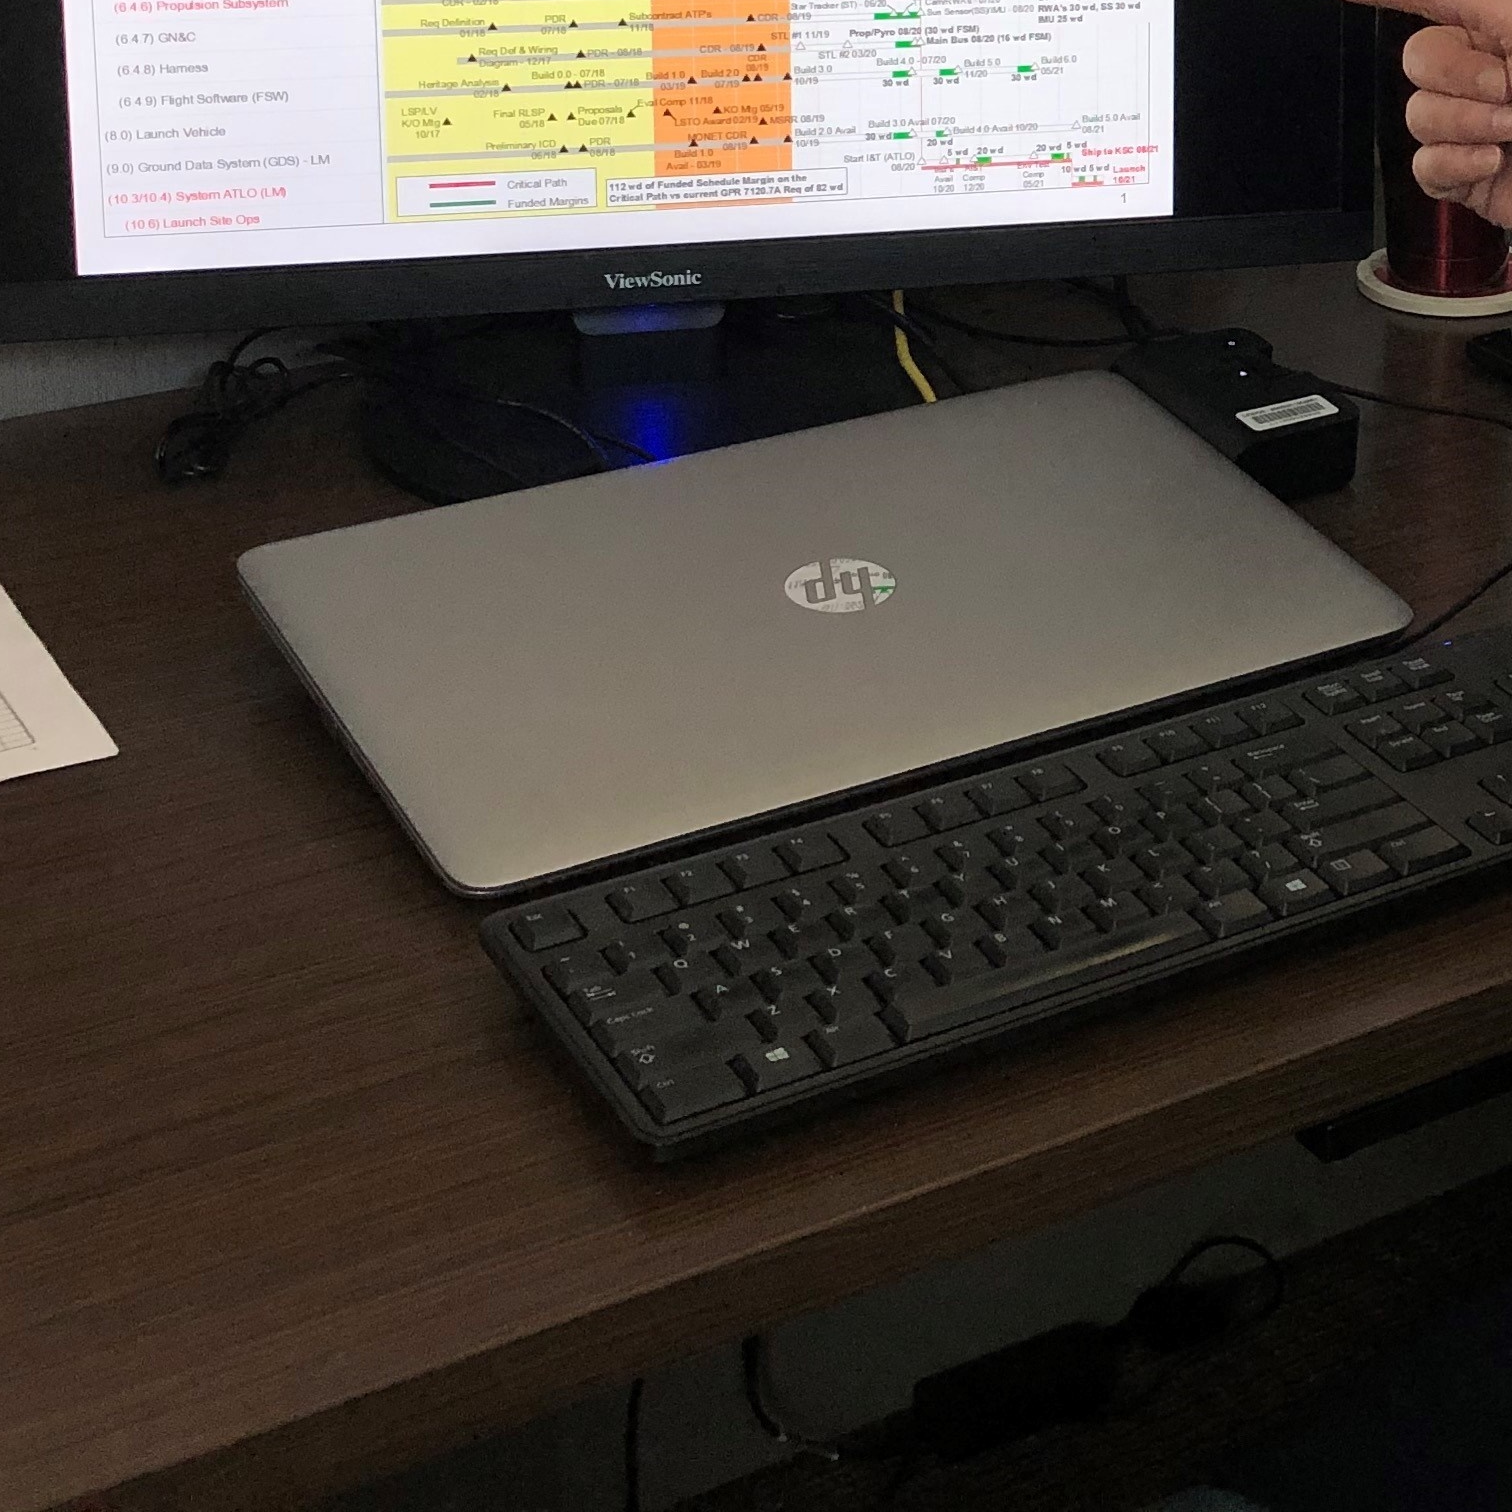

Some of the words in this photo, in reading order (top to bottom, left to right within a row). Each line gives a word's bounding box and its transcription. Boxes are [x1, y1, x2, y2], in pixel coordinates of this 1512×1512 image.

[157, 1, 219, 12] Propulsion
[223, 0, 288, 10] Subsystem
[161, 95, 194, 107] Flight
[197, 94, 248, 104] Software
[252, 91, 288, 103] (FSW)
[136, 128, 179, 139] Launch
[183, 127, 226, 137] Vehicle
[138, 161, 181, 172] Ground
[185, 160, 213, 170] Data
[217, 159, 260, 170] System
[263, 156, 299, 168] (GDS)
[311, 155, 330, 165] LM
[507, 180, 541, 189] Critical
[545, 178, 567, 187] Path
[508, 198, 548, 209] Funded
[550, 197, 590, 208] Margins
[163, 217, 206, 228] Launch
[210, 216, 232, 225] Site
[236, 215, 260, 226] Ops
[604, 270, 701, 288] ViewSonic
